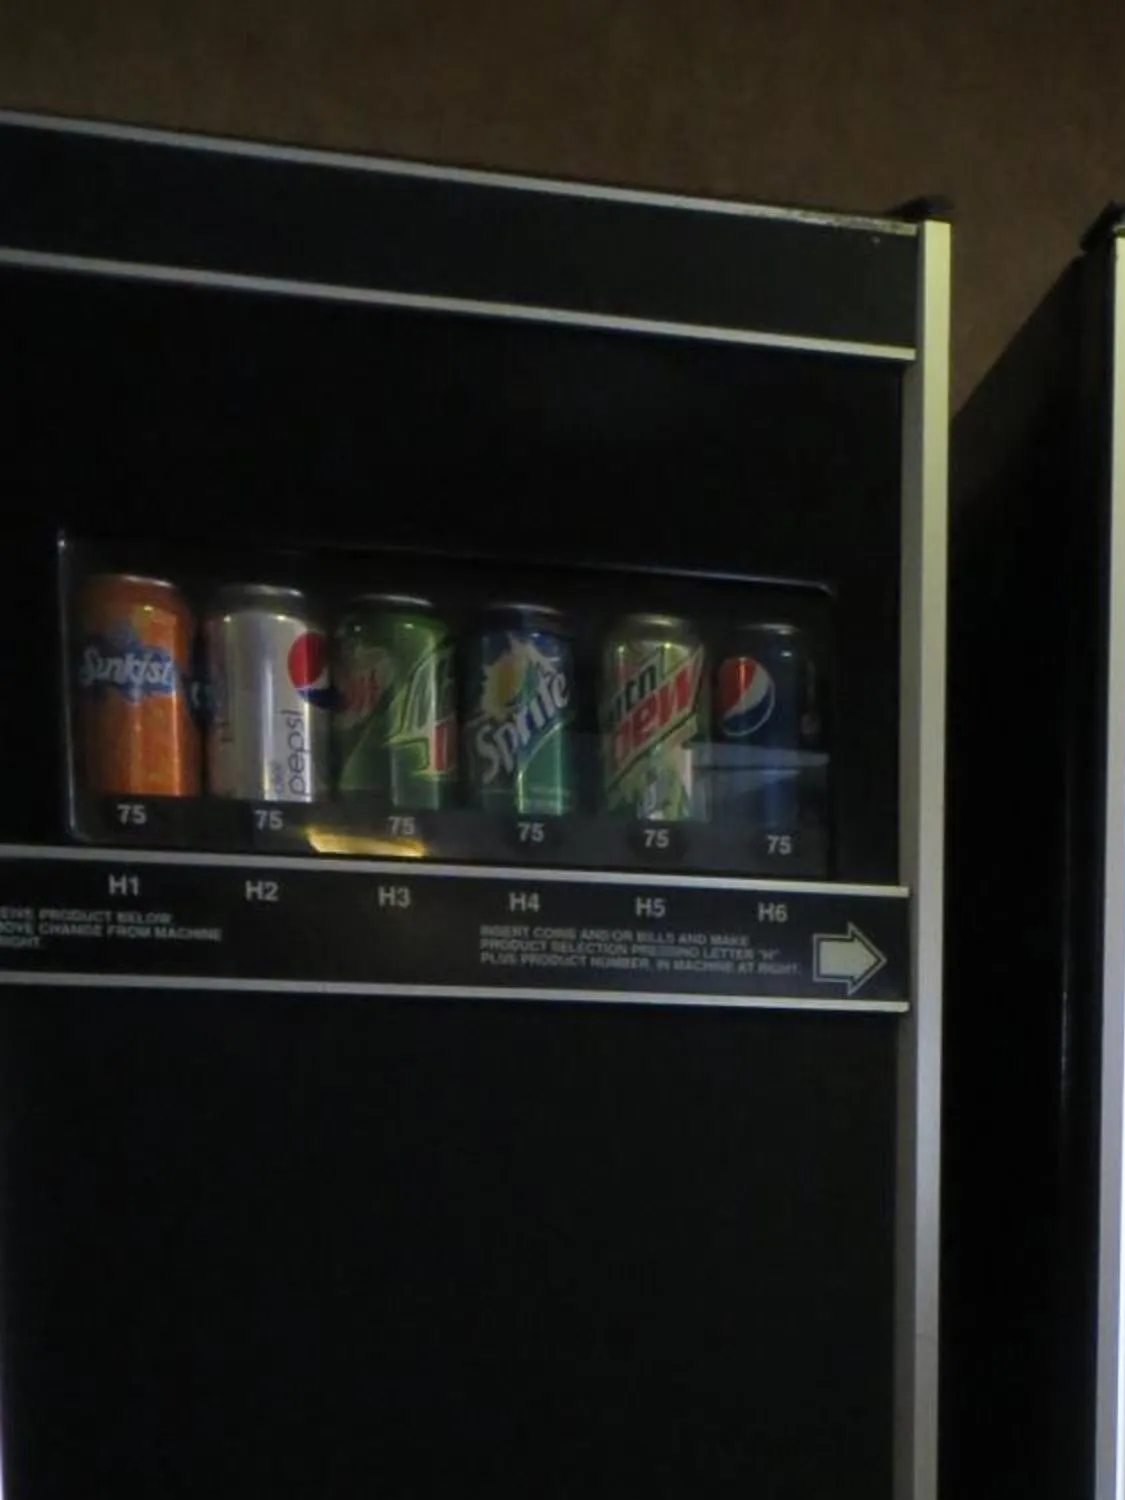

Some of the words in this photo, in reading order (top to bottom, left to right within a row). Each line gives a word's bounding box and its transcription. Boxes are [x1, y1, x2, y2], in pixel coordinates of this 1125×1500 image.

[477, 670, 570, 785] Sprite
[117, 804, 147, 825] 75
[254, 810, 284, 831] 75
[387, 815, 416, 836] 75
[518, 822, 545, 843] 75
[643, 828, 670, 849] 75
[766, 835, 793, 855] 75
[108, 875, 141, 897] H1
[245, 880, 279, 902] H2
[378, 886, 411, 909] H3
[509, 892, 541, 913] H4
[635, 897, 666, 918] H5
[38, 908, 113, 923] PRODUCT
[116, 911, 173, 924] BELOW
[758, 902, 788, 923] H6
[38, 922, 104, 936] CHANGE
[106, 924, 152, 938] FROM
[154, 926, 223, 942] MACHINE
[636, 930, 676, 944] BILLS
[678, 933, 707, 946] AND
[710, 934, 750, 947] MAKE
[480, 938, 548, 952] PRODUCT
[551, 940, 628, 956] SELECTION
[702, 946, 755, 961] LETTER
[480, 951, 516, 966] PLUS
[520, 953, 588, 967] PRODUCT
[674, 958, 735, 973] MACHINE
[737, 961, 757, 974] AT
